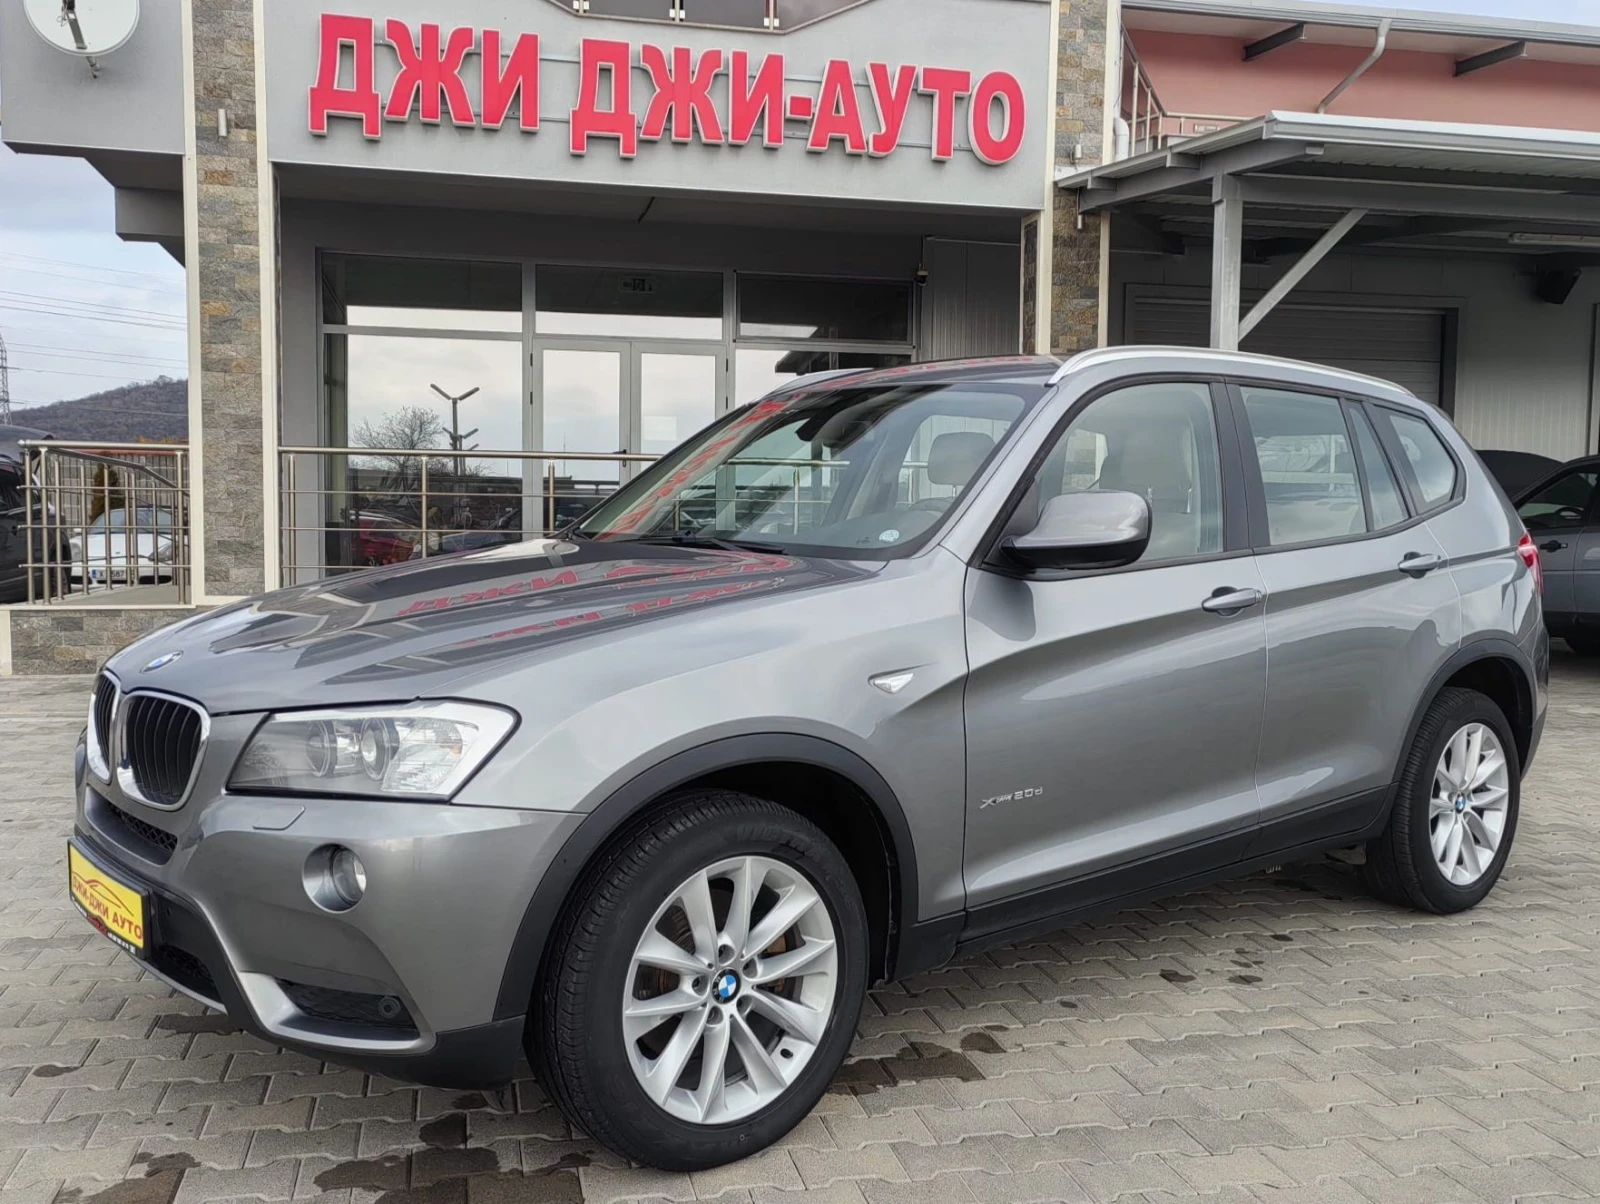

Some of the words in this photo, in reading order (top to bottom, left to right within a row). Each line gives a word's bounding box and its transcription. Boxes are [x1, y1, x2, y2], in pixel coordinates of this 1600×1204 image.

[308, 13, 540, 141] ДЖИ
[569, 37, 1027, 166] ДЖИ-АУТО
[72, 876, 109, 919] ДЖИ-ДЖИ
[112, 911, 143, 939] АУТО
